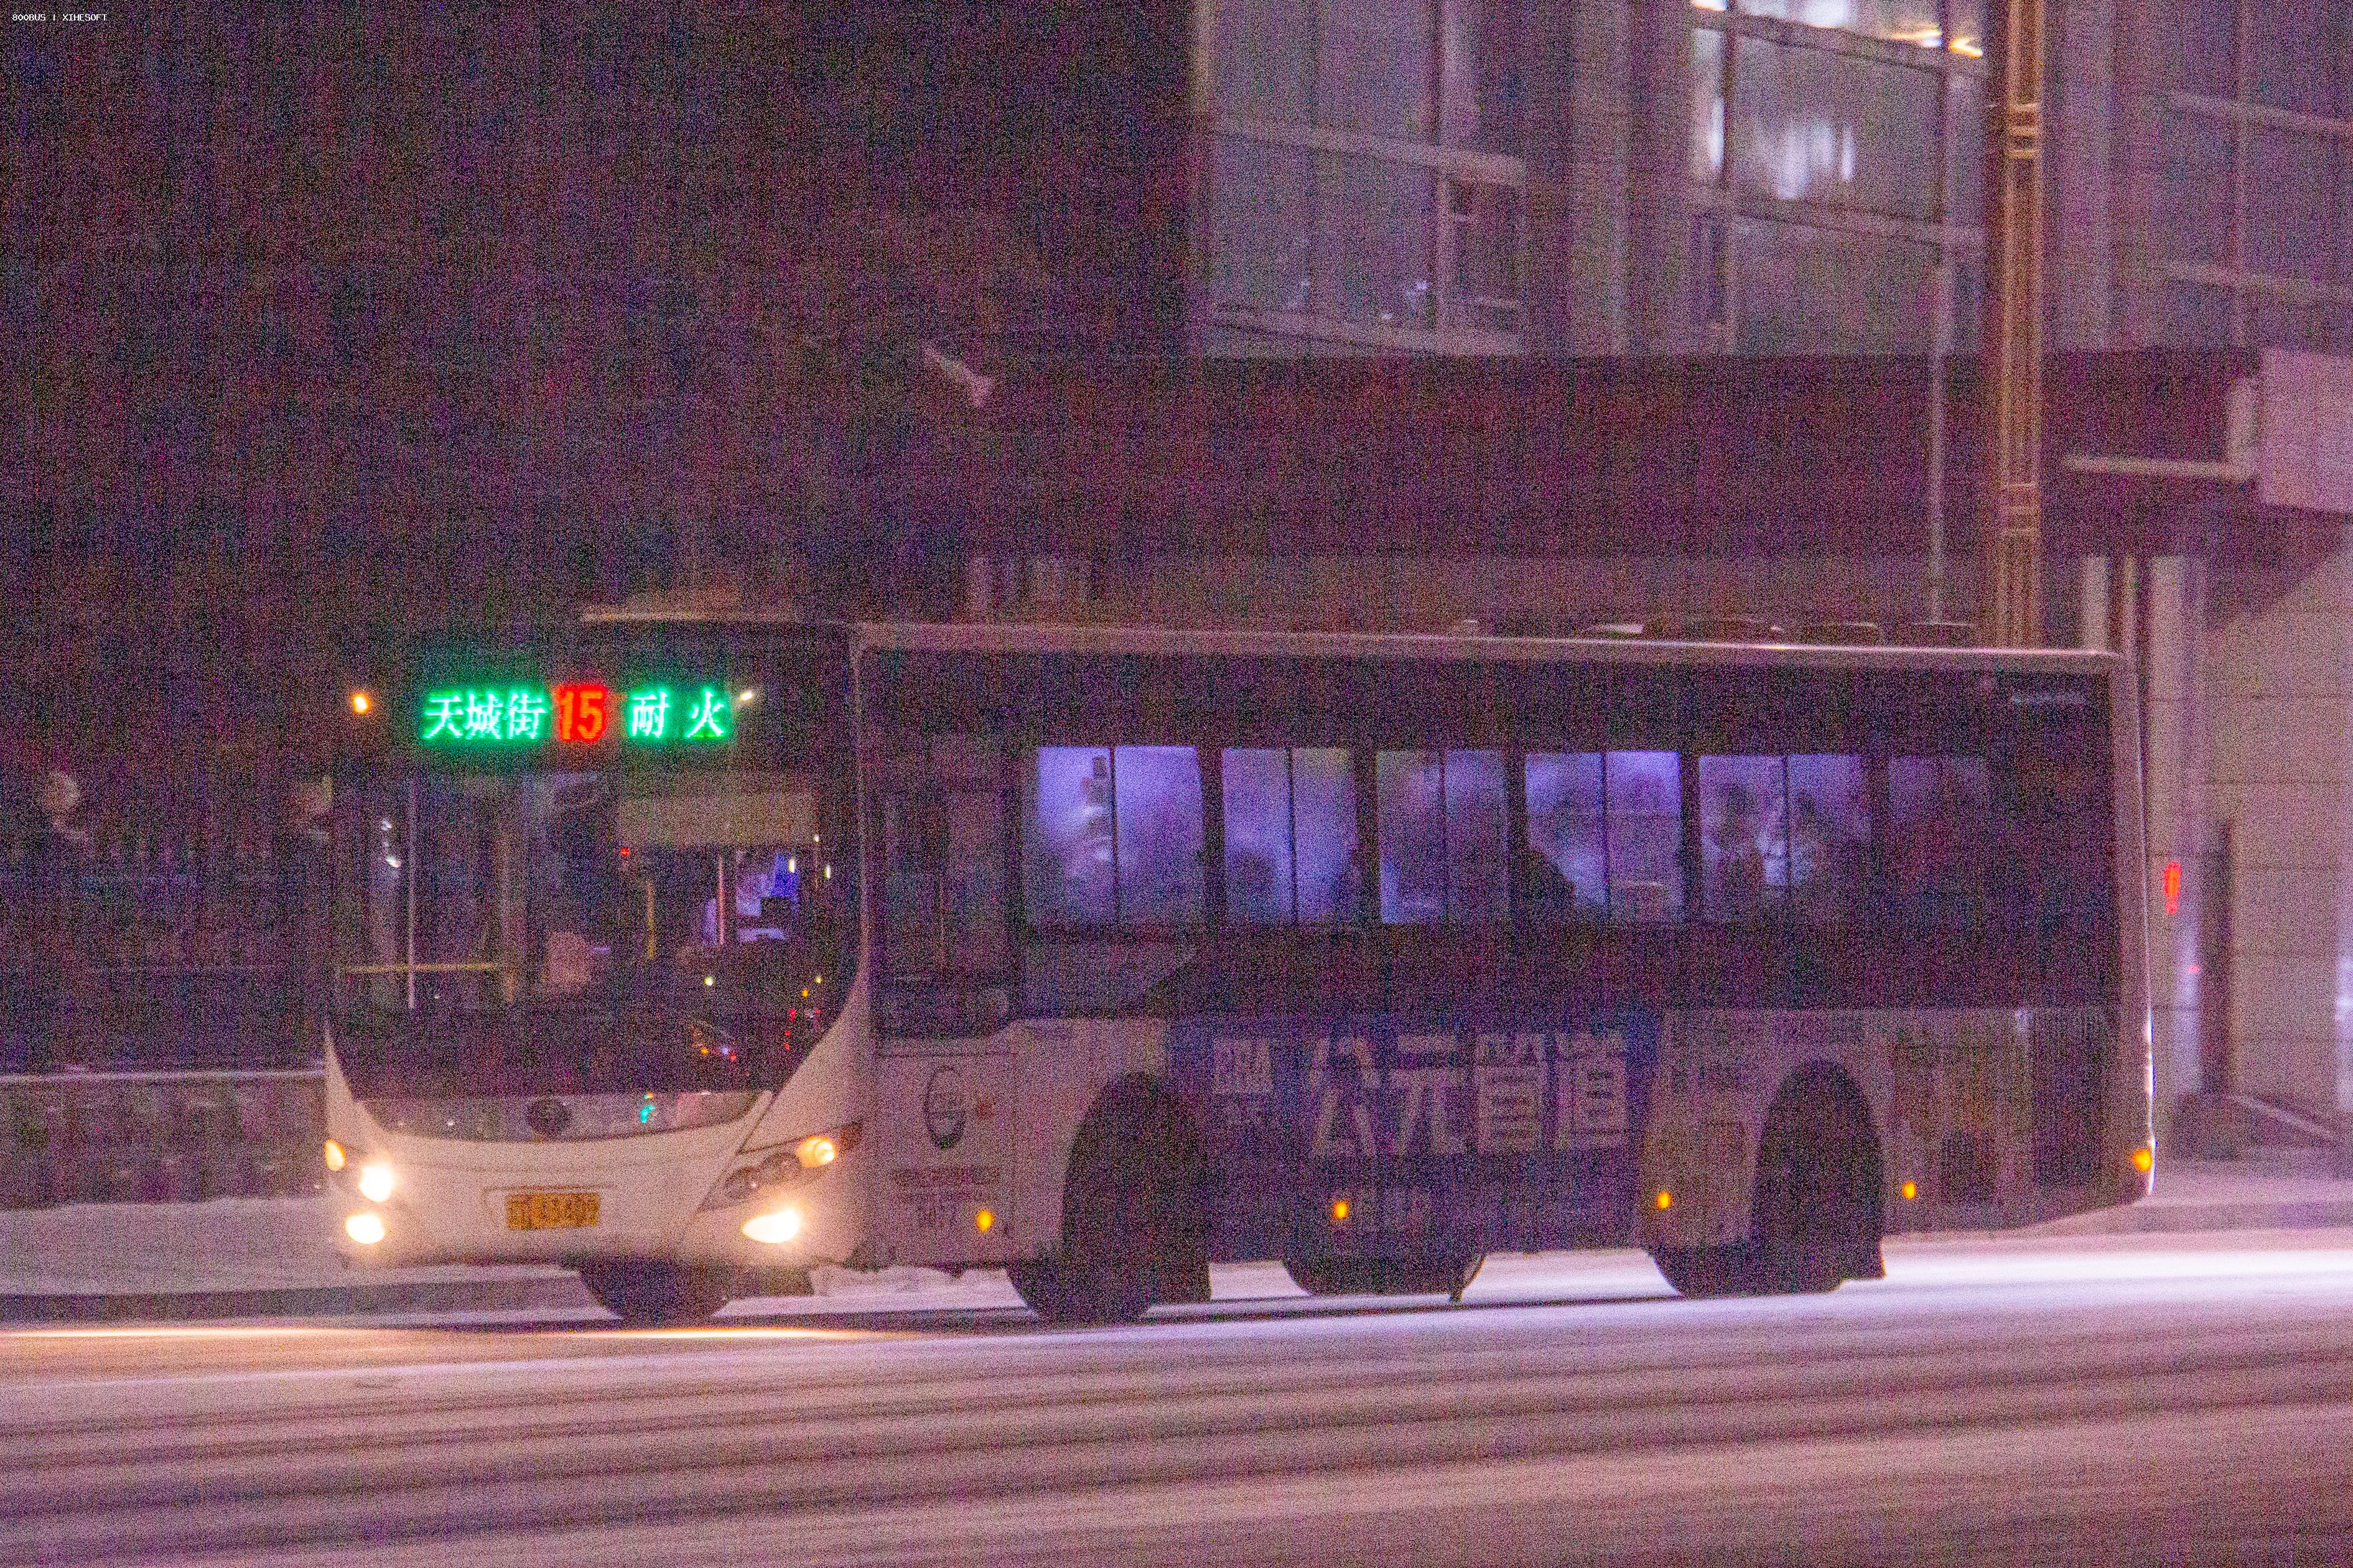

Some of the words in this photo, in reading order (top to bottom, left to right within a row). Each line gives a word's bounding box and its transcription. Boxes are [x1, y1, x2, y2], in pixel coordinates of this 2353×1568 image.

[423, 690, 547, 740] 天城街
[560, 689, 604, 741] 15
[1309, 1030, 1629, 1157] 公元管道
